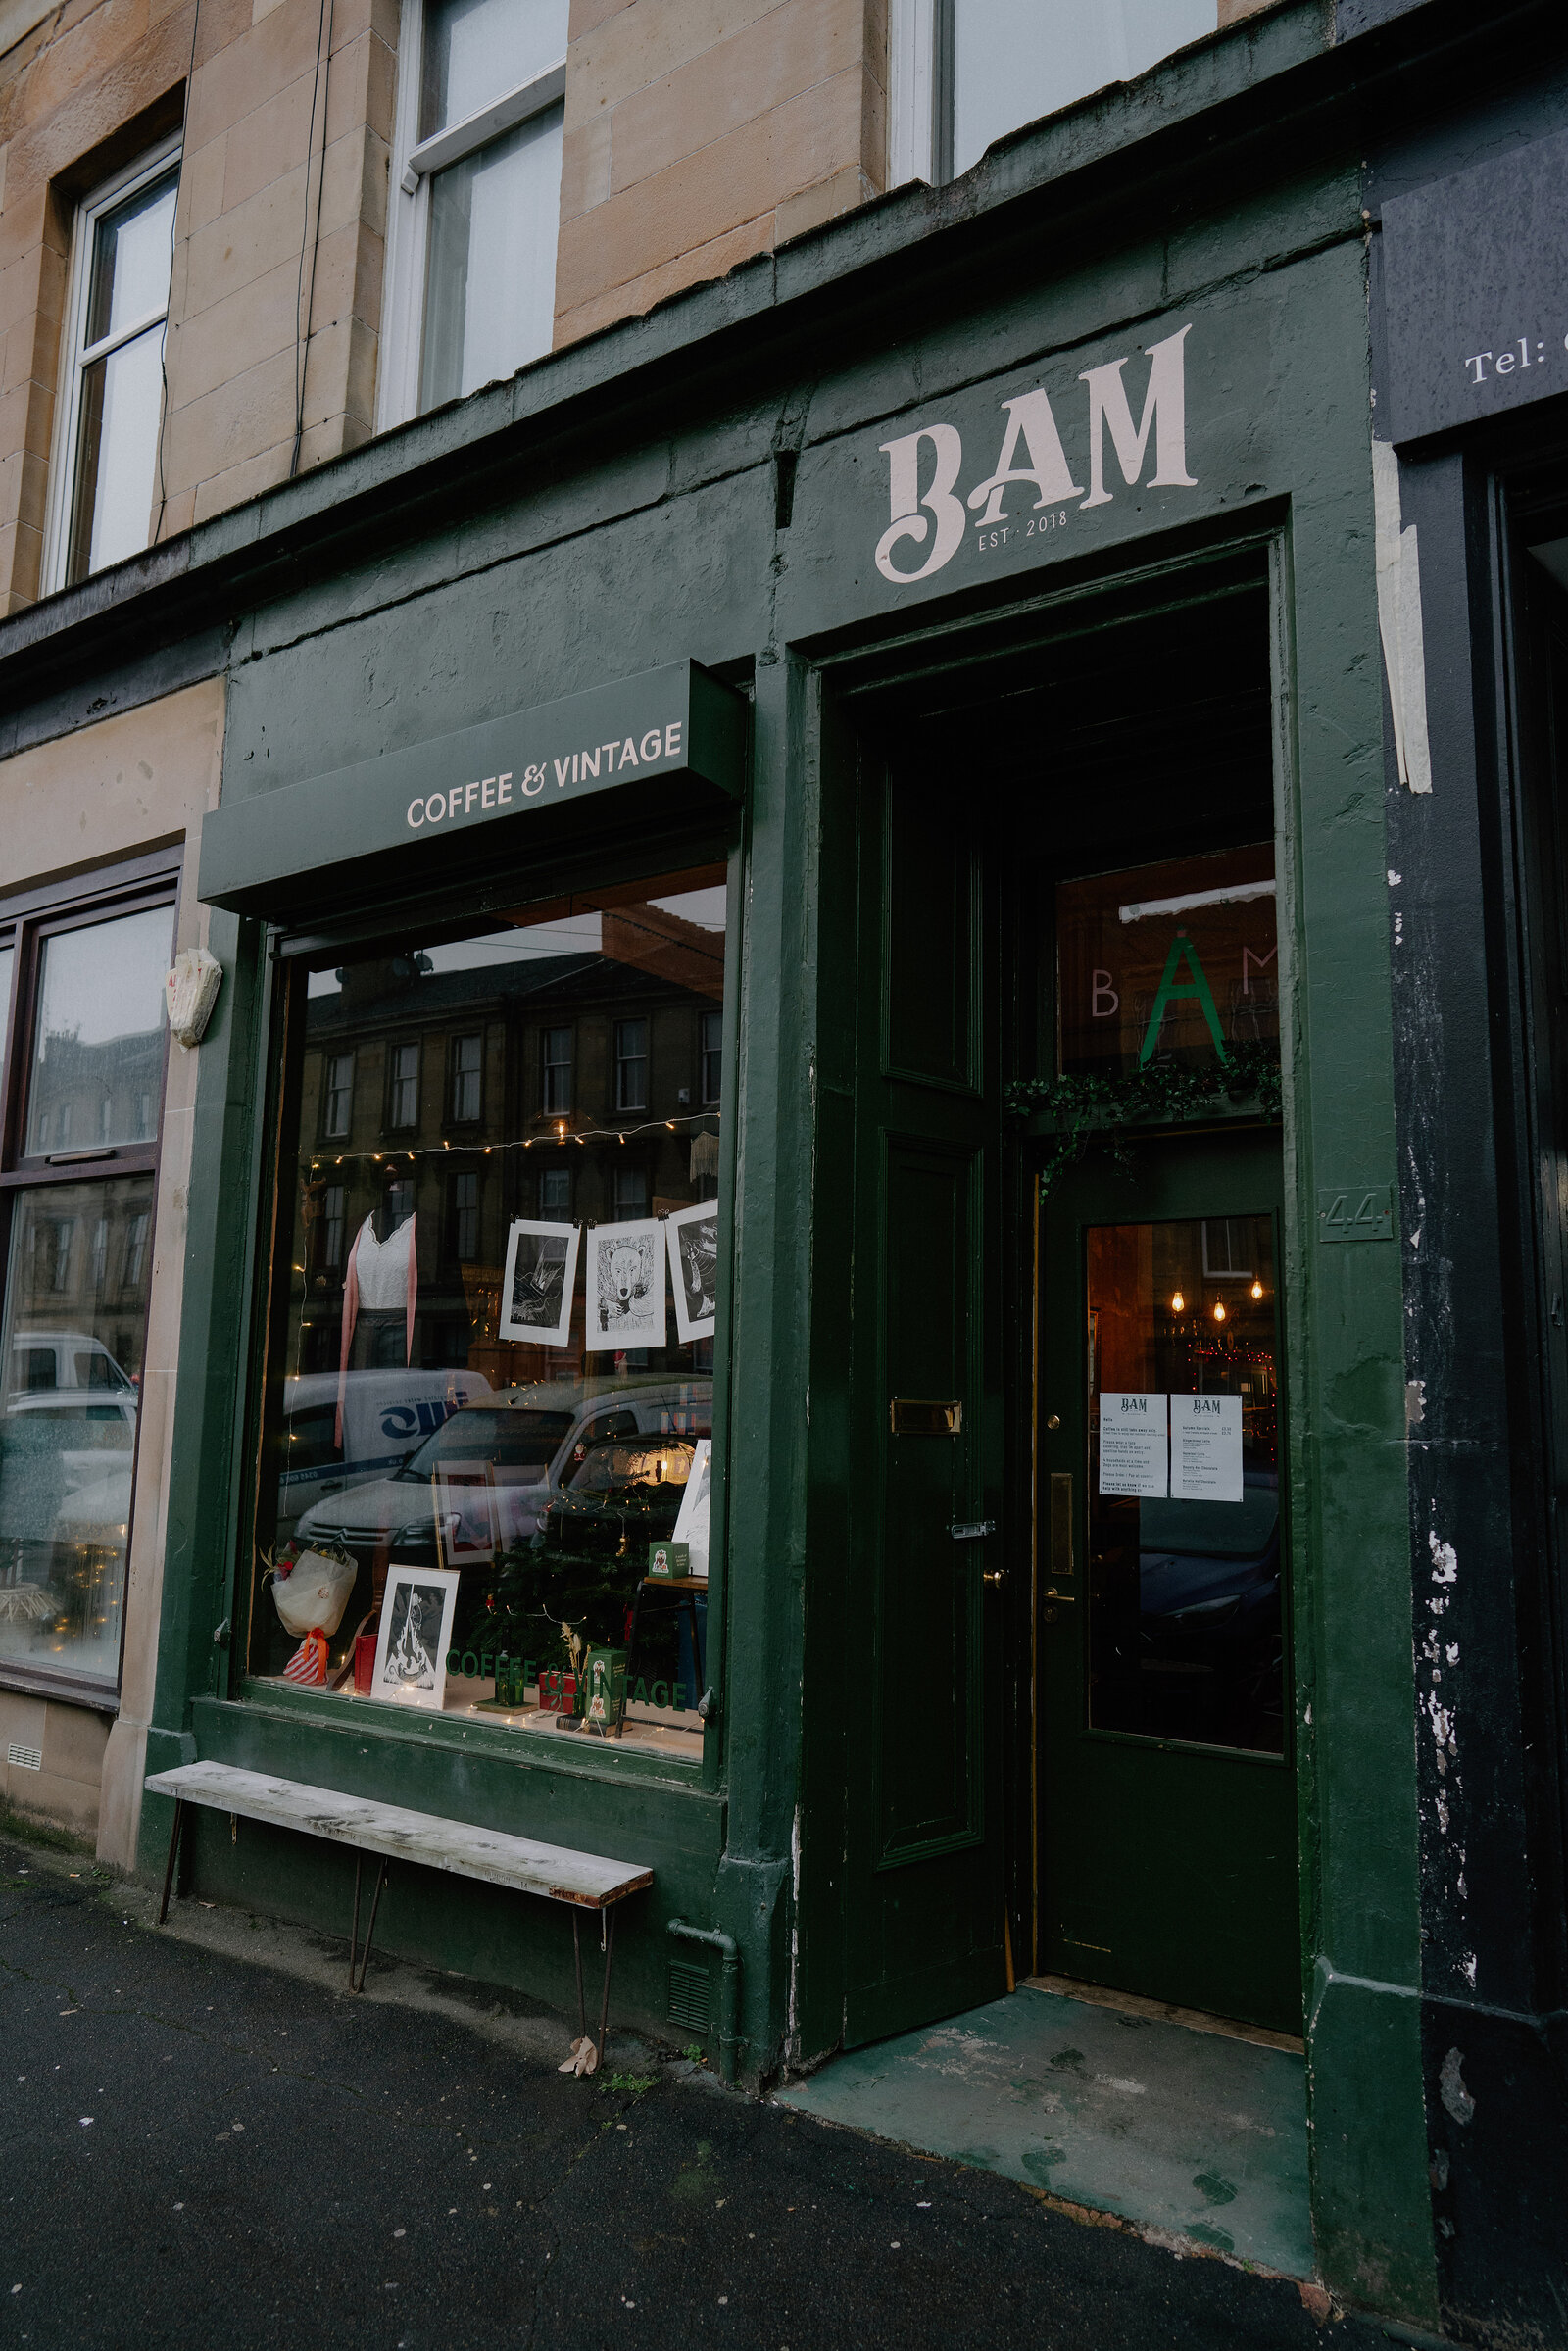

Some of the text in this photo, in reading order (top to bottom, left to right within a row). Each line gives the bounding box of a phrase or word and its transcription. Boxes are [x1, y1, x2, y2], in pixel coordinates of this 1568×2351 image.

[1465, 337, 1545, 383] Tel:
[874, 323, 1199, 585] BAM
[1026, 511, 1067, 537] 2018
[407, 721, 682, 828] COFFEE & VINTAGE
[1326, 1193, 1383, 1233] 44
[1121, 1399, 1147, 1412] BAM
[1193, 1400, 1220, 1414] BAM
[446, 1649, 536, 1689] COFFEE
[573, 1667, 687, 1712] VINTAGE
